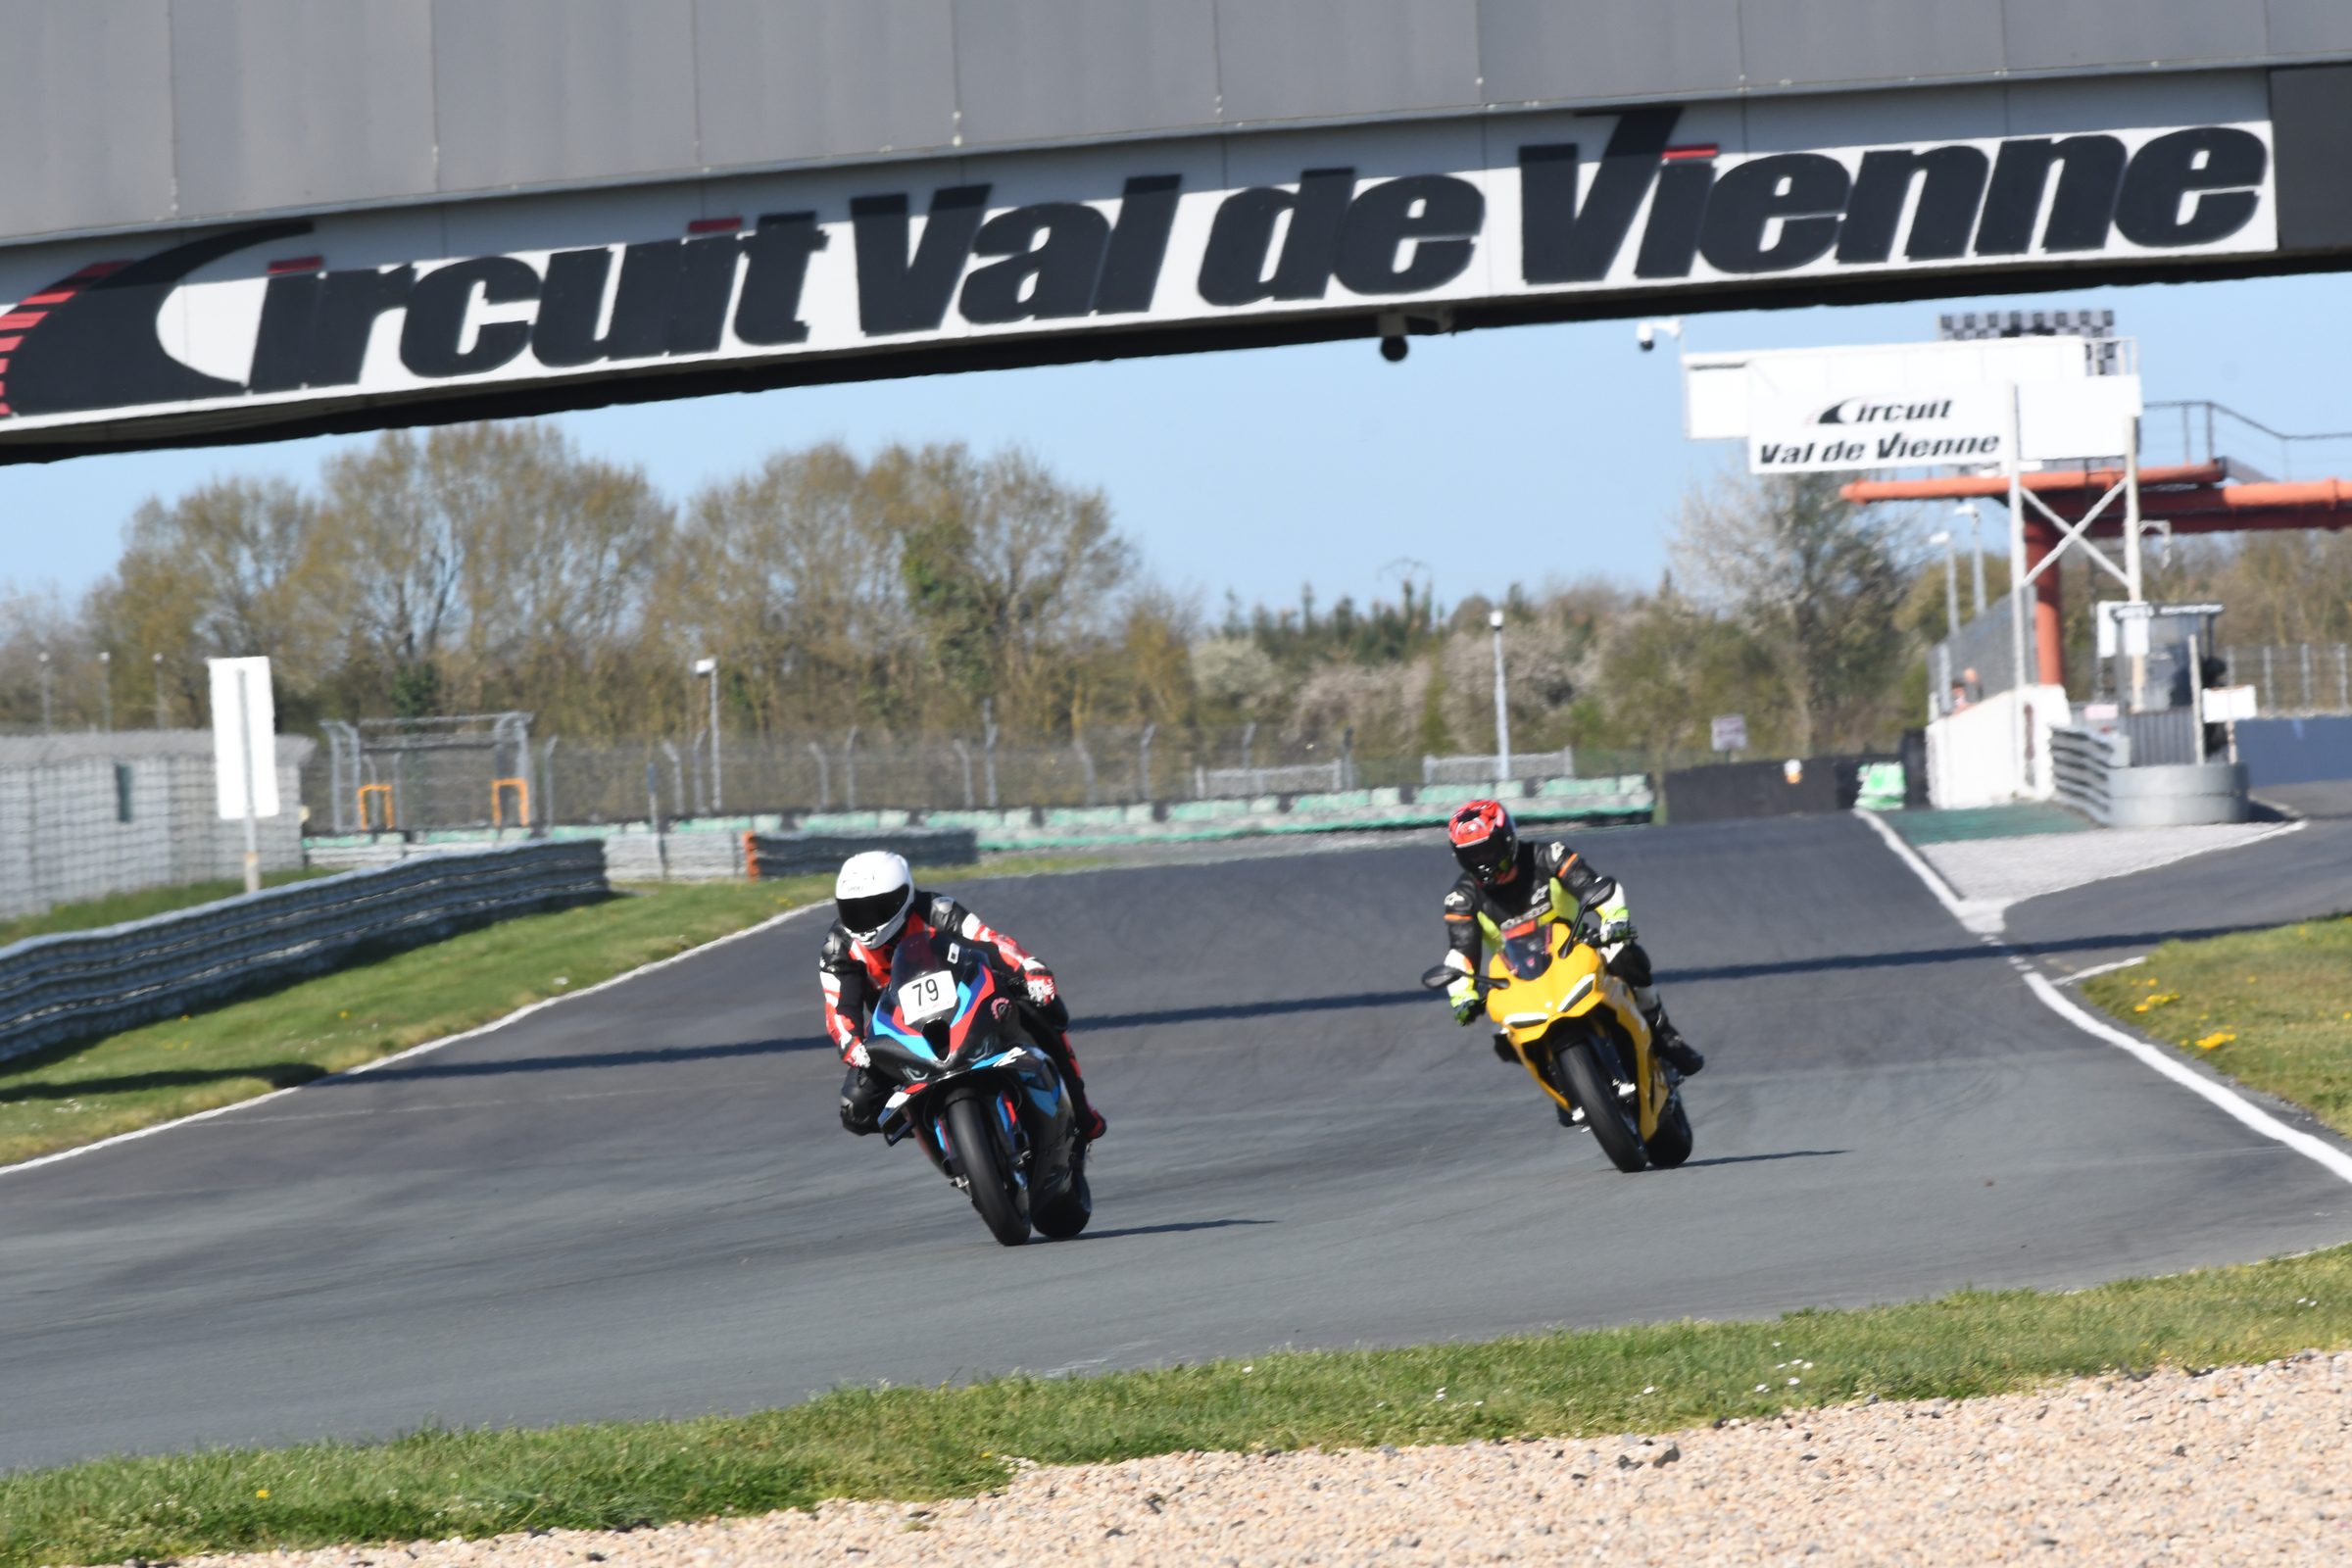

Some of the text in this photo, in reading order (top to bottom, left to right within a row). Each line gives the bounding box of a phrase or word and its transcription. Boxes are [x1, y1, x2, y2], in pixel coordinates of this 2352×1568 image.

[2, 106, 2268, 416] Circuit Val de Vienne
[1816, 396, 1953, 424] Circuit
[1760, 431, 2001, 465] Val de Vienne
[911, 978, 939, 1006] 79
